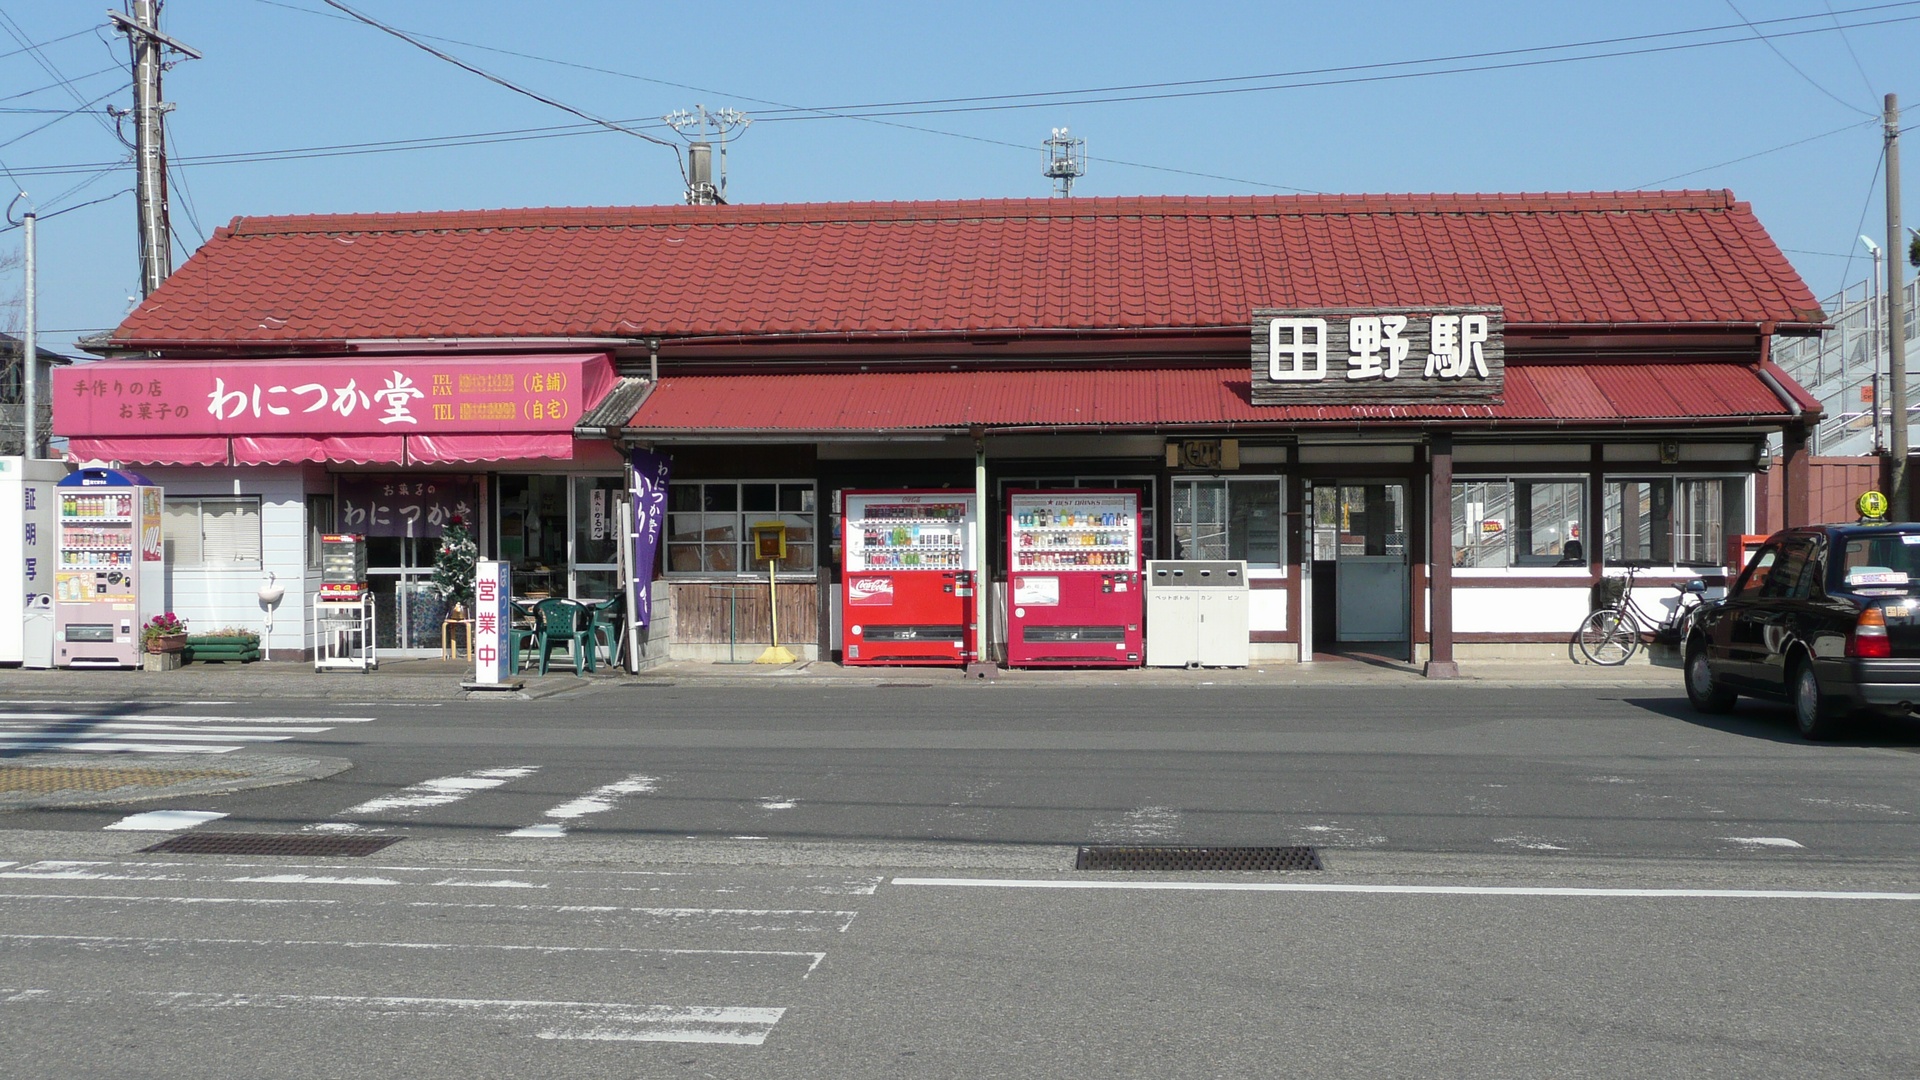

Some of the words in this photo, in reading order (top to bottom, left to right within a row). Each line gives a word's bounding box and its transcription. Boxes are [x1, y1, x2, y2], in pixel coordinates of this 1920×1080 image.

[1269, 315, 1490, 381] 田野駅
[72, 379, 163, 398] 手作りの店
[432, 374, 453, 385] TEL
[207, 369, 425, 426] わにつか堂
[432, 386, 453, 396] FAX
[118, 403, 190, 421] お菓子の
[432, 404, 455, 421] TEL
[383, 483, 436, 497] お菓子の
[648, 461, 668, 545] わにつか堂の
[855, 578, 891, 592] Coca-Cola
[478, 578, 497, 668] 営業中
